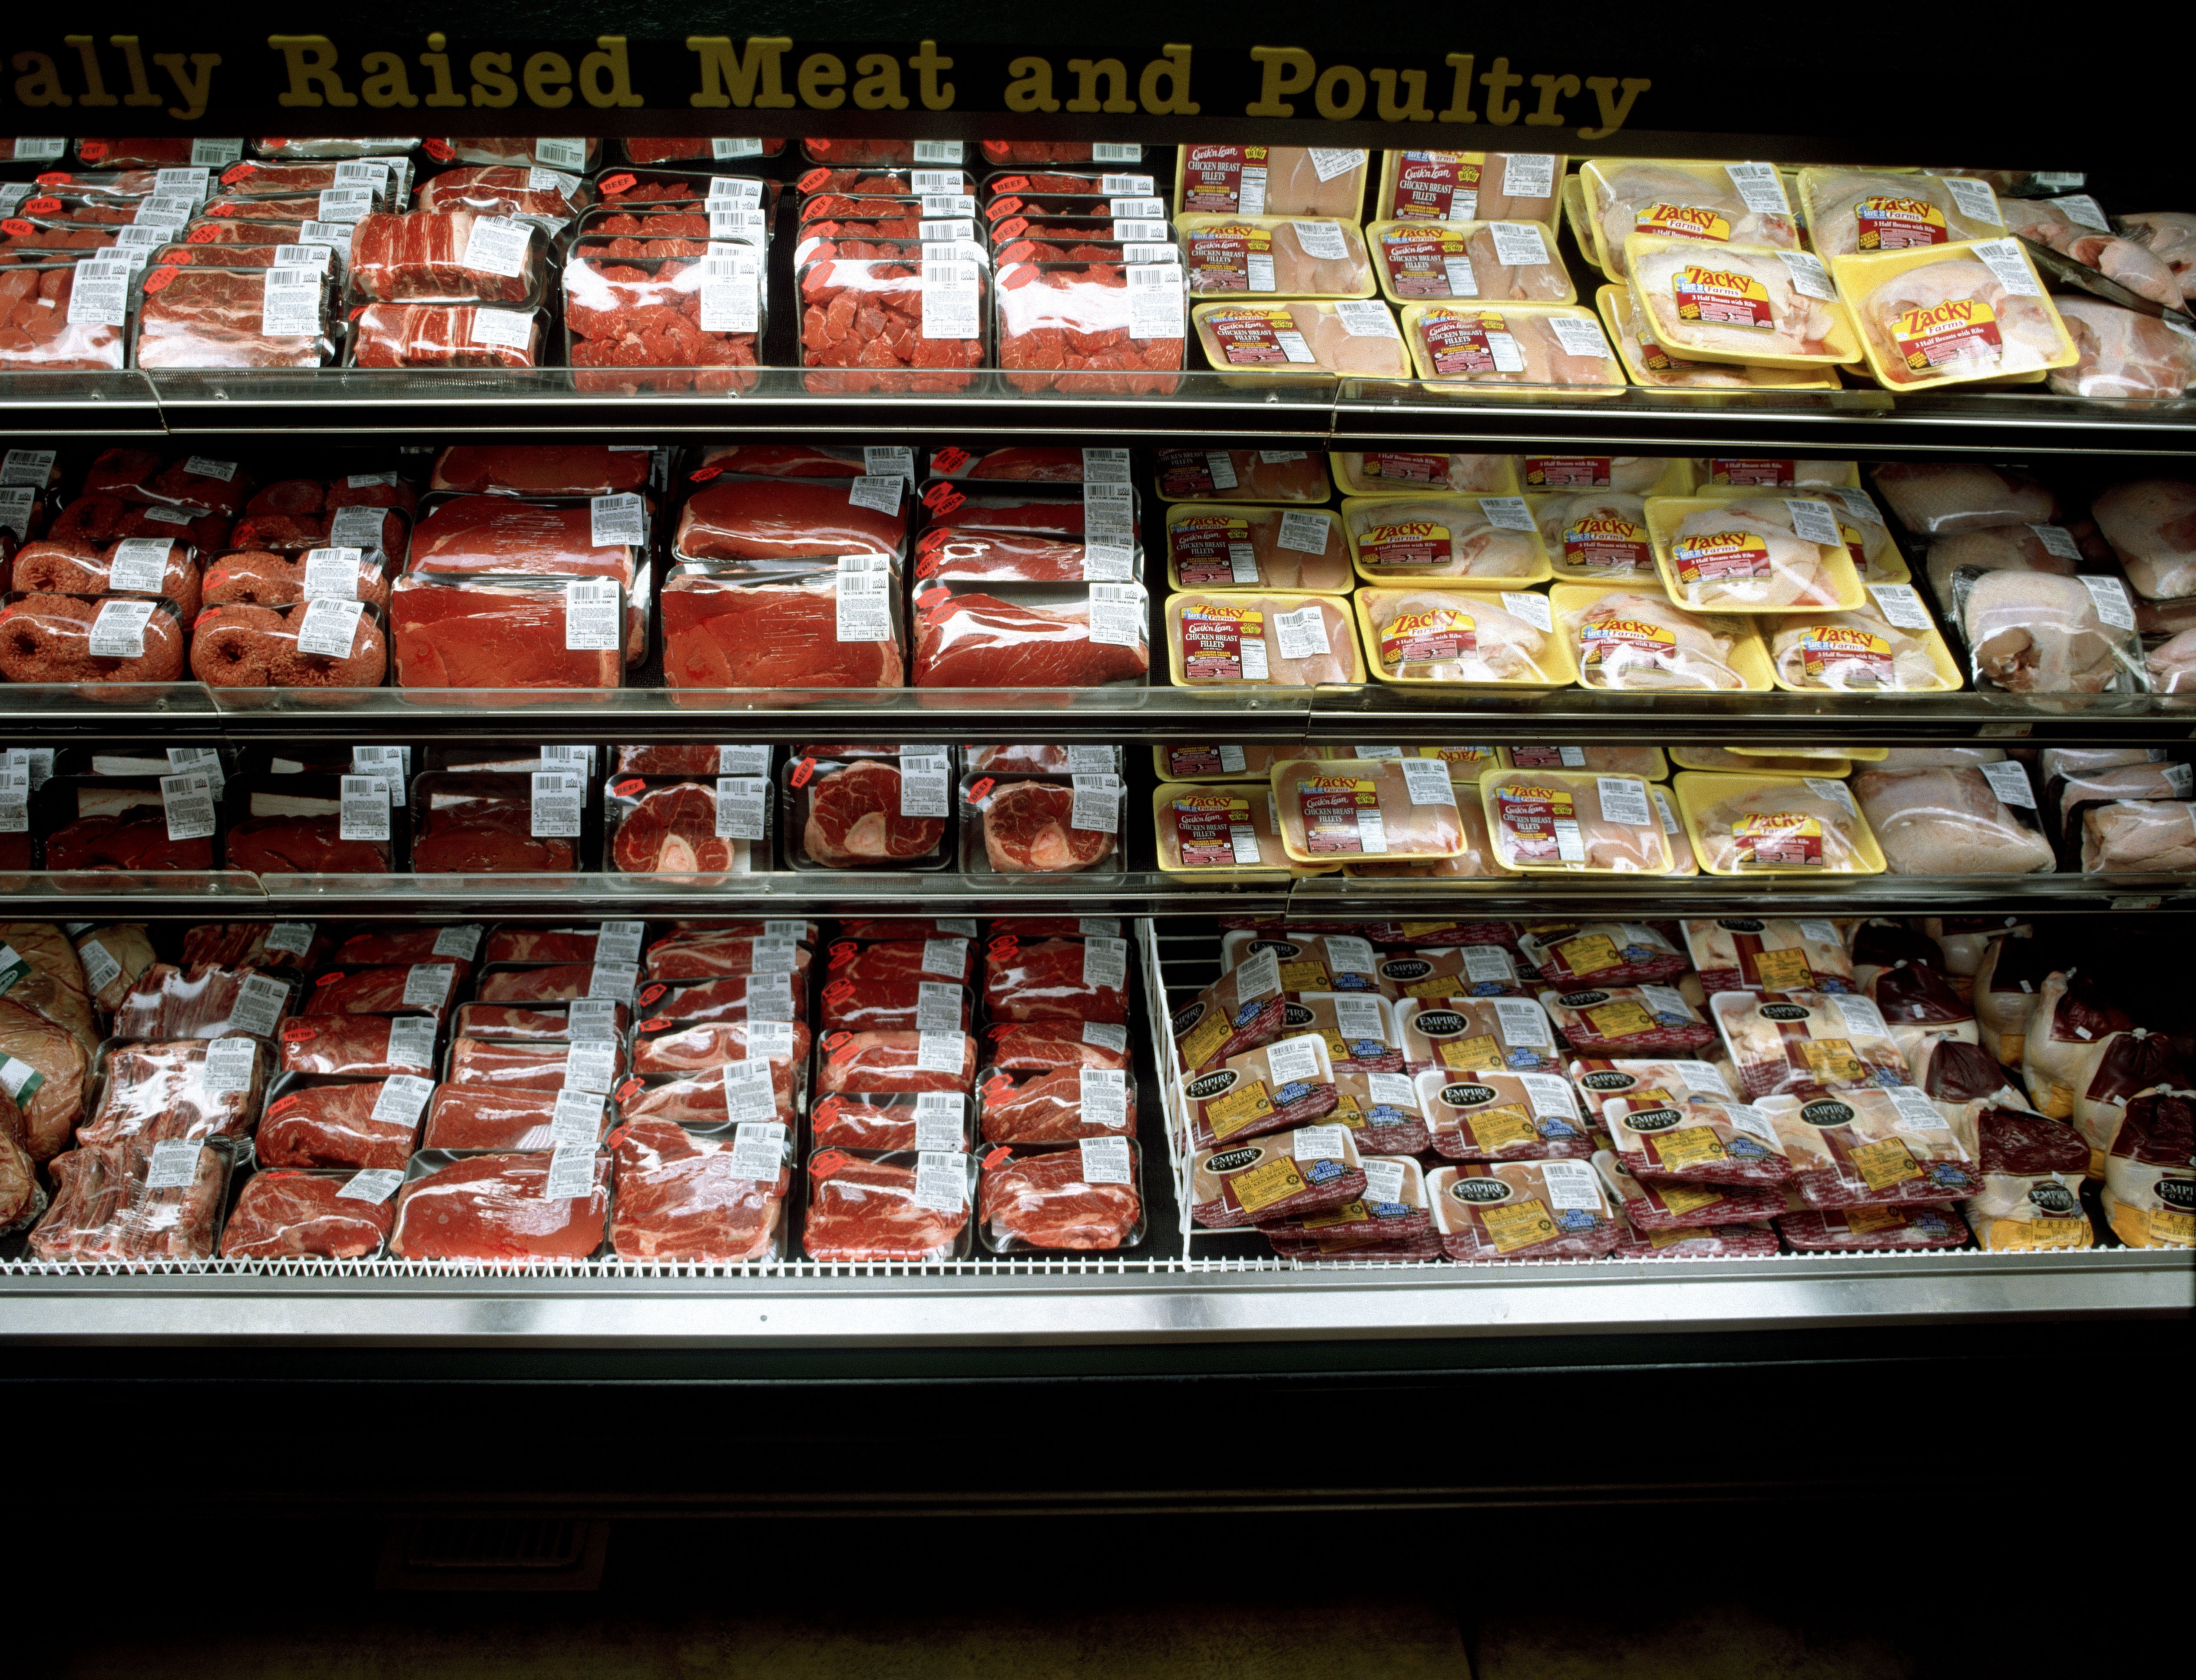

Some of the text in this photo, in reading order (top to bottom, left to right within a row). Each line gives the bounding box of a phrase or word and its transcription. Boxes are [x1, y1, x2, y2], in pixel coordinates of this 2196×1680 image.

[1, 32, 1653, 142] ally Raised Meat and Poultry
[1192, 147, 1238, 161] Qwik'n Lean
[1188, 162, 1240, 172] CHICKEN BREAST
[1405, 167, 1451, 180] Qwik'n Lean
[41, 175, 65, 183] VEAL
[803, 172, 824, 189] BEEF
[1201, 171, 1225, 181] FILLETS
[604, 177, 630, 191] BEEF
[997, 179, 1022, 191] BEEF
[1399, 180, 1453, 194] CHICKEN BREAST
[1412, 192, 1437, 202] FILLETS
[30, 201, 56, 210] VEAL
[806, 200, 827, 218] BEEF
[991, 200, 1016, 216] BEEF
[1869, 197, 1931, 218] Zacky
[1654, 204, 1718, 229] Zacky
[1888, 212, 1921, 221] Farms
[5, 221, 27, 231] VEAL
[998, 222, 1021, 239] BEEF
[1206, 226, 1253, 236] Zacky
[1669, 220, 1703, 232] Farms
[1396, 228, 1445, 238] Zacky
[1003, 245, 1028, 263] BEEF
[807, 264, 829, 289] BEEF
[1006, 268, 1032, 287] BEEF
[1688, 268, 1753, 293] Zacky
[1707, 286, 1740, 297] Farms
[1731, 298, 1743, 307] with
[1904, 300, 1974, 334] Zacky
[1928, 320, 1964, 334] Farms
[1921, 337, 1935, 347] Half
[1936, 333, 1957, 344] Breasts
[1958, 331, 1971, 339] with
[1971, 327, 1984, 335] Ribs
[936, 496, 965, 514] THICK
[1184, 517, 1230, 526] Zacky
[1577, 519, 1635, 537] Zacky
[1179, 532, 1220, 544] Qwik'n Lean
[1373, 522, 1434, 542] Zacky
[1177, 542, 1204, 550] CHICKEN
[1684, 532, 1747, 550] Zacky
[1705, 546, 1736, 554] Farms
[1197, 604, 1246, 618] Zacky
[1395, 609, 1458, 634] Zacky
[1597, 619, 1660, 636] Zacky
[1189, 625, 1214, 634] Qwik'n
[1412, 626, 1444, 635] Farms
[1814, 627, 1874, 648] Zacky
[1438, 750, 1480, 763] Zacky
[794, 761, 811, 784] BEEF
[1313, 776, 1358, 787] Zacky
[616, 782, 640, 795] BEEF
[971, 780, 989, 801] BEEF
[1509, 786, 1554, 798] Zacky
[1187, 797, 1231, 807] Zacky
[1306, 797, 1348, 808] Qwik'n Lean
[1746, 814, 1807, 831] Zacky
[1386, 962, 1425, 972] EMPIRE
[1419, 1015, 1461, 1025] EMPIRE
[1191, 1071, 1231, 1090] EMPIRE
[1584, 1073, 1629, 1083] EMPIRE
[1191, 1080, 1230, 1096] KOSHER
[1445, 1088, 1490, 1098] EMPIRE
[1803, 1104, 1848, 1117] EMPIRE
[1628, 1111, 1677, 1124] EMPIRE
[1211, 1149, 1257, 1166] EMPIRE
[1212, 1155, 1257, 1171] KOSHER
[1308, 1162, 1344, 1177] BEST TASTING
[1458, 1183, 1504, 1193] EMPIRE
